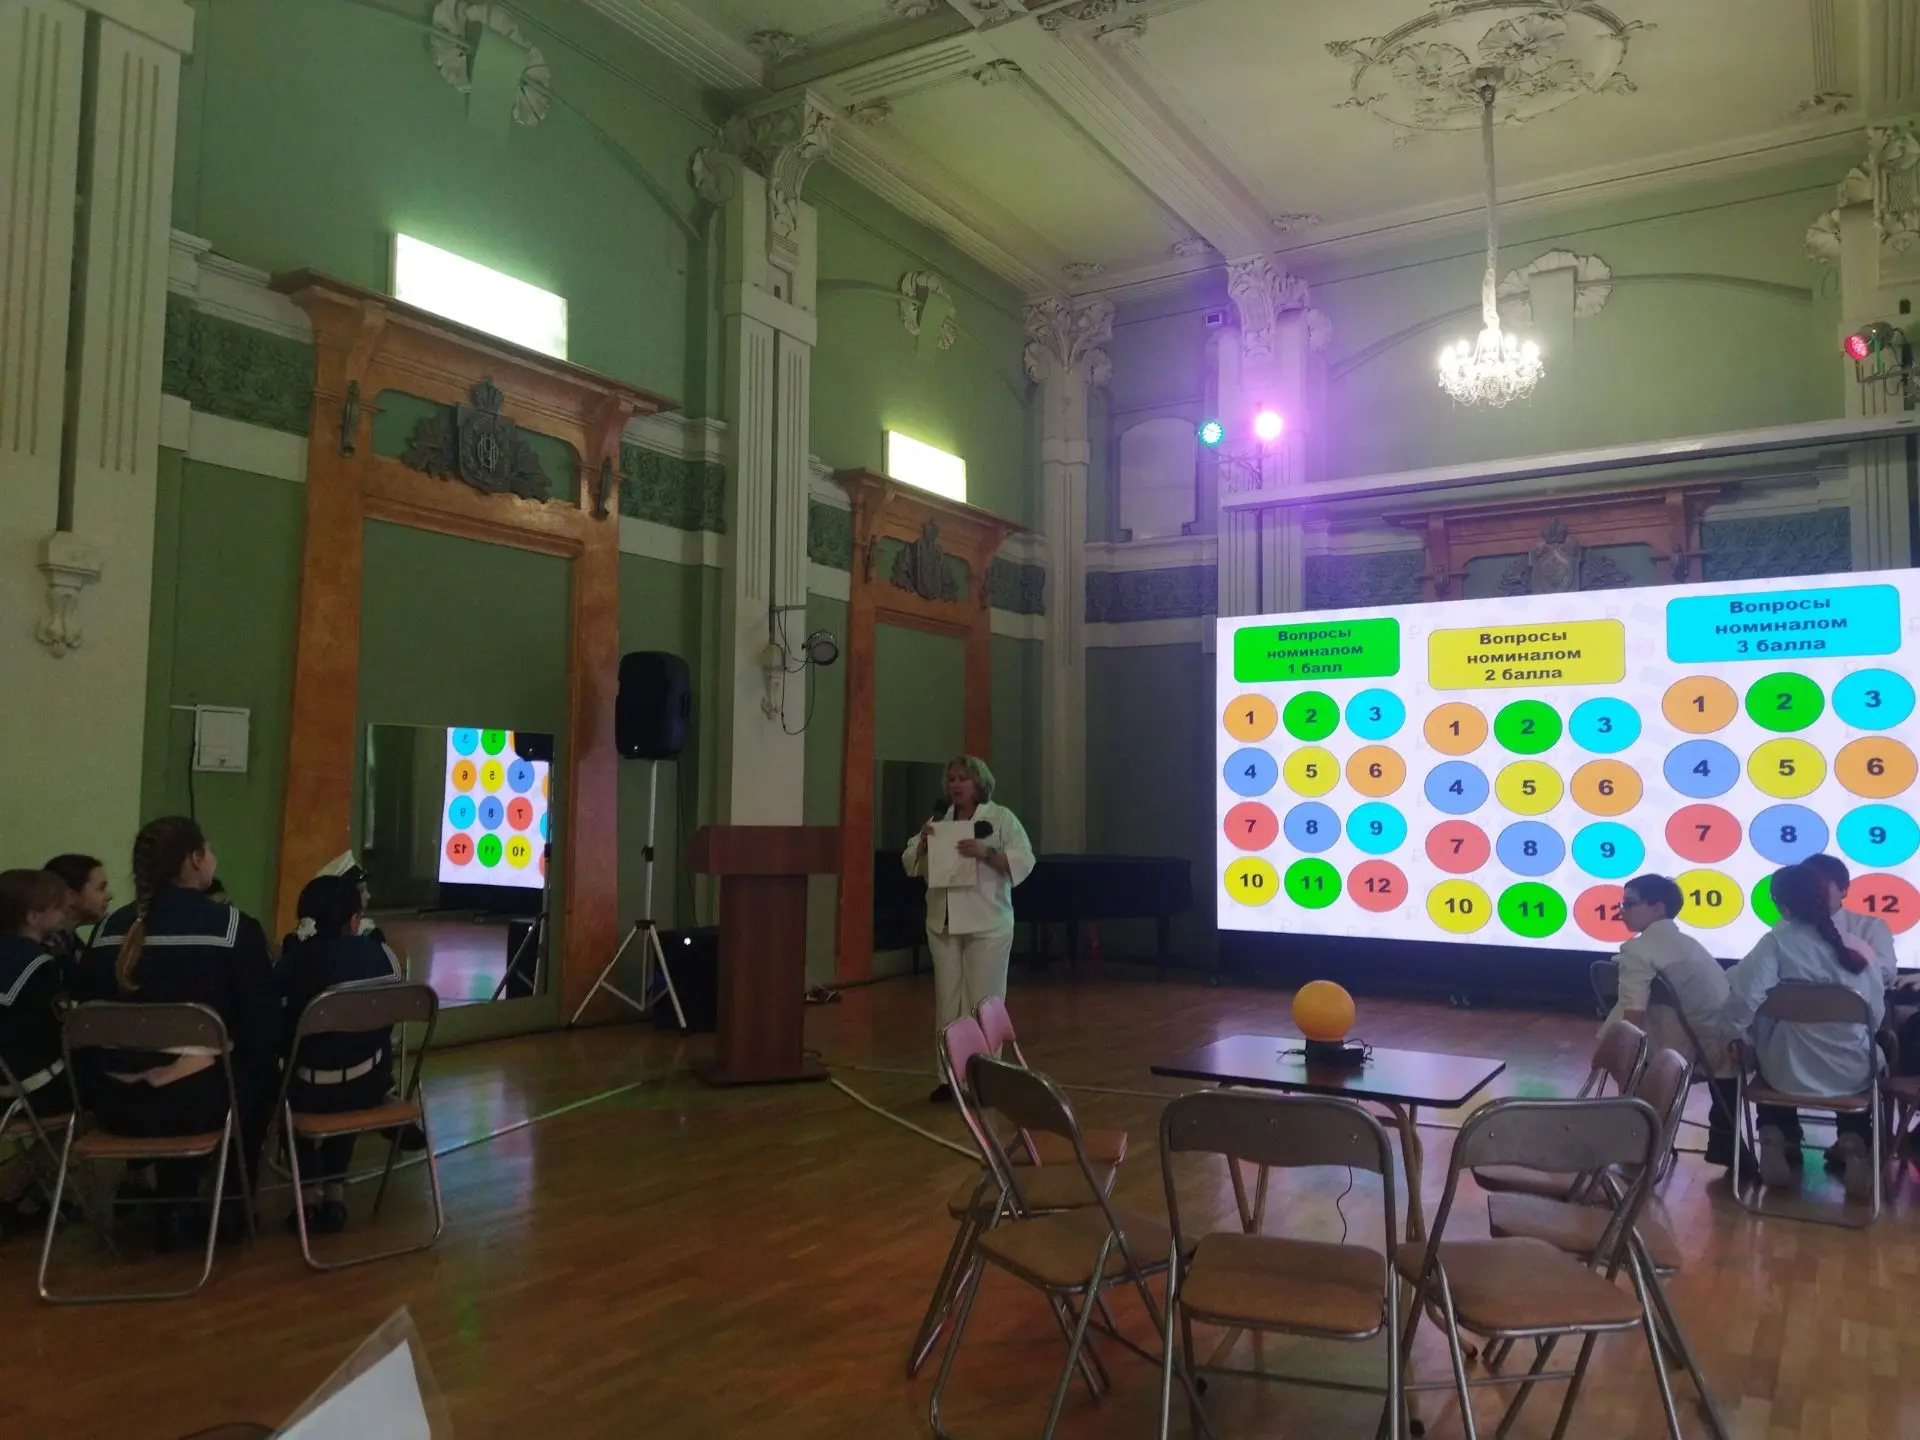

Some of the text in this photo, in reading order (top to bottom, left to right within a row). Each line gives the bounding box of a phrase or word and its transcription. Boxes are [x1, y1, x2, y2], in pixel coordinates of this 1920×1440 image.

[1728, 597, 1831, 614] Вопросы
[1715, 617, 1848, 635] номиналом
[1277, 627, 1352, 642] Вопросы
[1480, 631, 1567, 646] Вопросы
[1267, 644, 1364, 658] номиналом
[1737, 640, 1825, 653] 3 балла
[1467, 648, 1582, 665] номиналом
[1287, 663, 1342, 674] 1 балл
[1485, 668, 1563, 682] 2 балла
[1693, 696, 1704, 712] 1
[1776, 692, 1792, 711] 2
[1865, 690, 1881, 707] 3
[1245, 710, 1254, 725] 1
[1304, 708, 1318, 724] 2
[1369, 707, 1381, 721] 3
[1450, 721, 1459, 736] 1
[1521, 719, 1534, 735] 2
[1598, 717, 1612, 733] 3
[1245, 764, 1256, 779] 4
[1306, 764, 1317, 778] 5
[1369, 763, 1382, 778] 6
[1693, 760, 1710, 776] 4
[1779, 759, 1795, 776] 5
[1867, 758, 1884, 775] 6
[1449, 780, 1463, 795] 4
[1522, 780, 1536, 795] 5
[1599, 780, 1613, 795] 6
[1245, 820, 1256, 832] 7
[1306, 820, 1318, 834] 8
[1370, 821, 1383, 835] 9
[1695, 825, 1711, 841] 7
[1781, 826, 1797, 843] 8
[1869, 827, 1886, 844] 9
[1450, 839, 1464, 854] 7
[1524, 840, 1537, 856] 8
[1600, 842, 1615, 858] 9
[1240, 874, 1263, 887] 10
[1302, 875, 1324, 891] 11
[1365, 878, 1391, 893] 12
[1445, 898, 1472, 914] 10
[1690, 890, 1722, 907] 10
[1862, 894, 1900, 914] 12
[1519, 901, 1545, 917] 11
